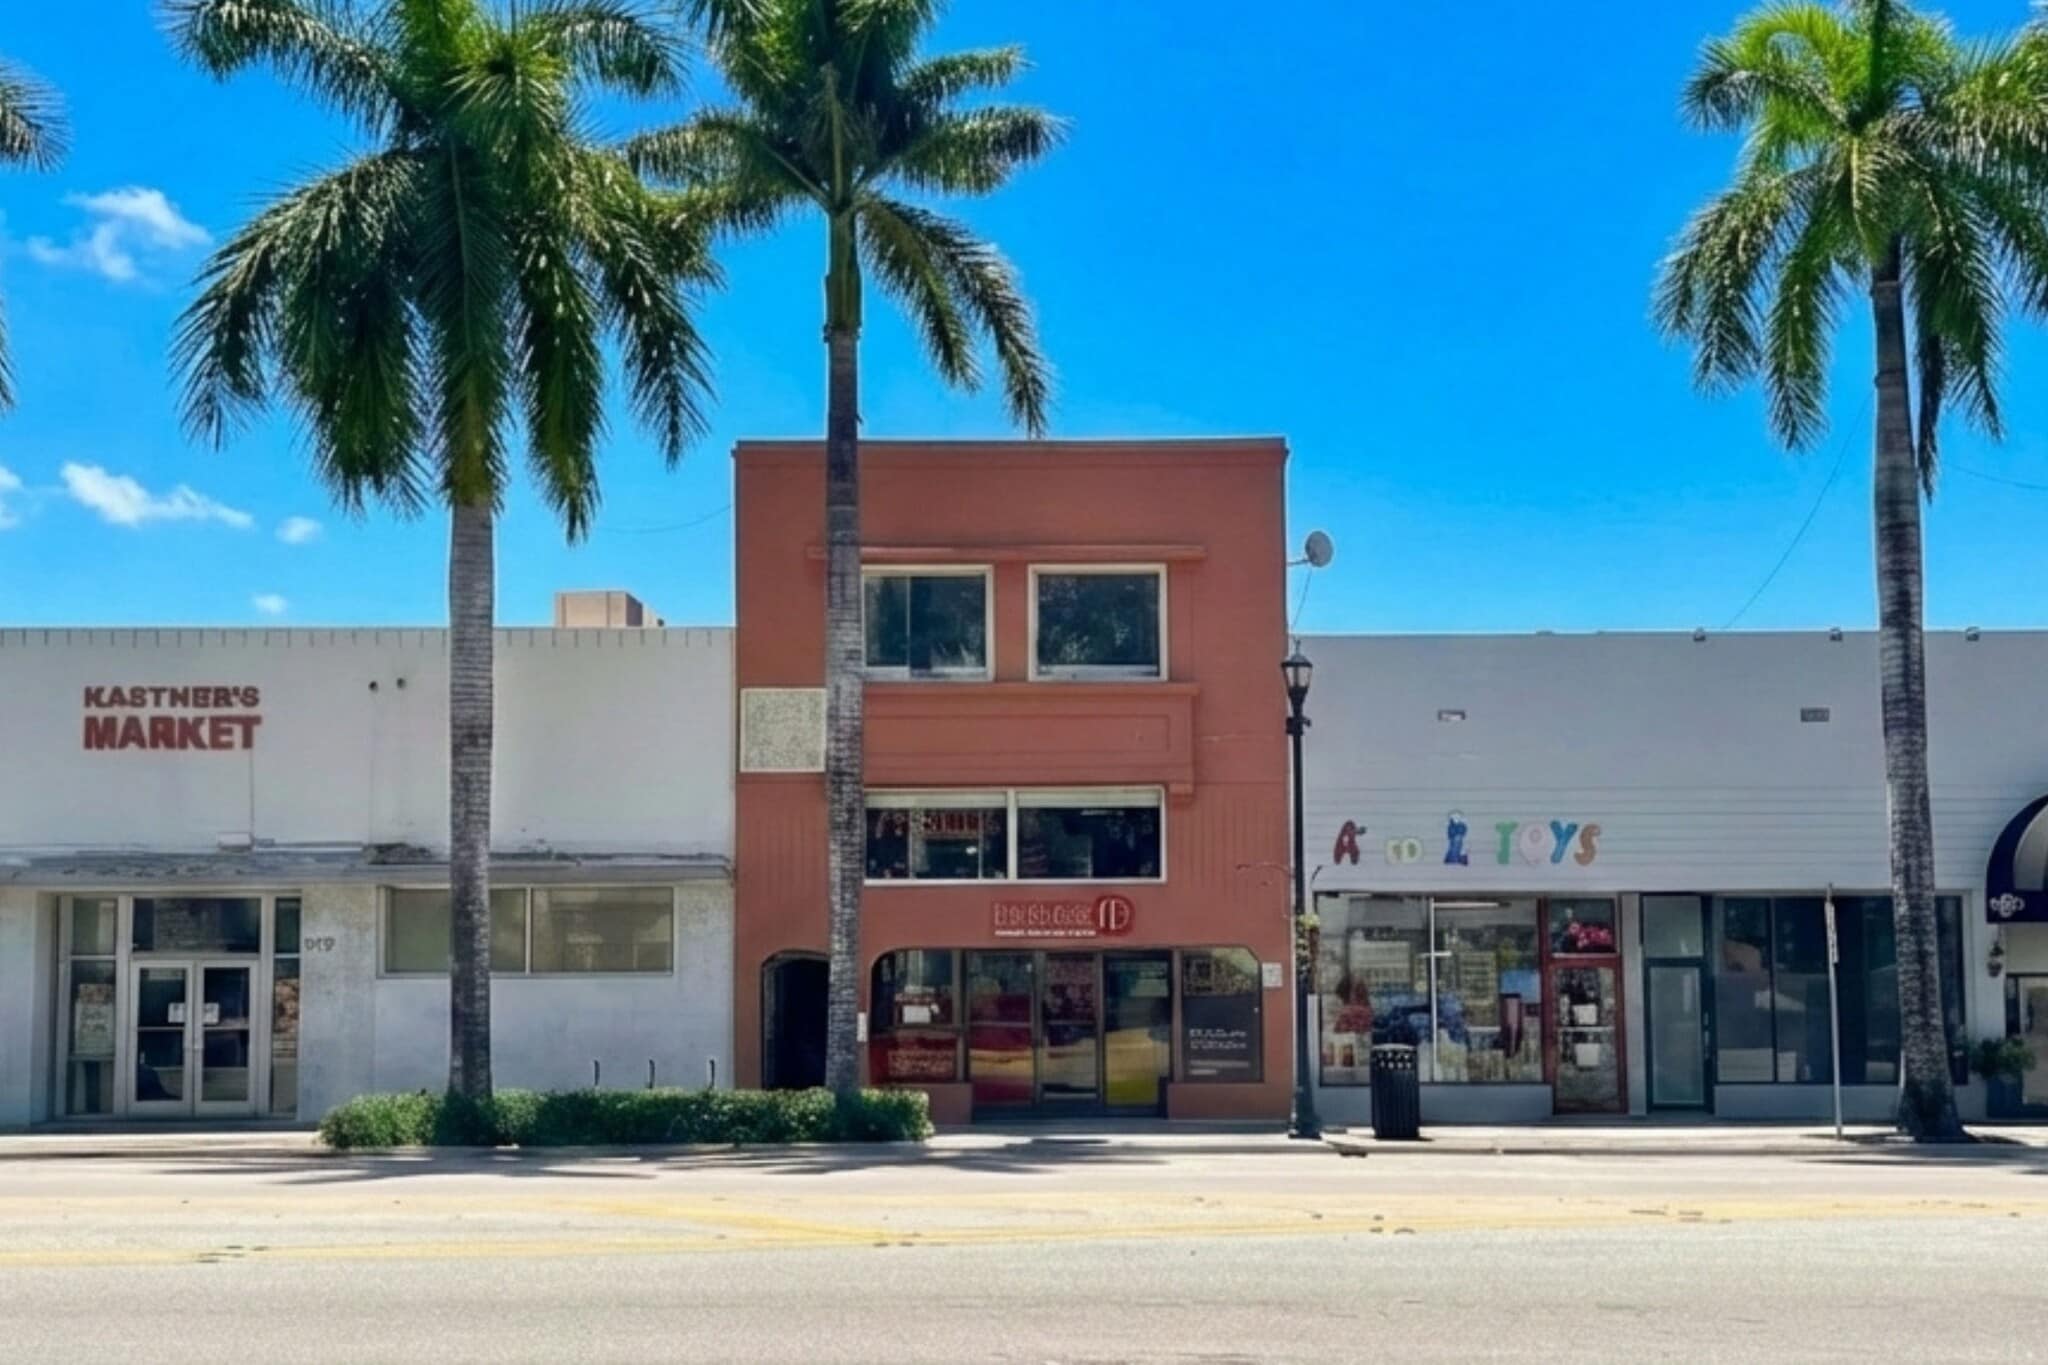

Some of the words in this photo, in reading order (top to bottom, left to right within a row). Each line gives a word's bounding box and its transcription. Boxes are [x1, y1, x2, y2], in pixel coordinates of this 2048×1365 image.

[84, 686, 260, 708] KASTNER'S
[84, 715, 262, 750] MARKET
[1333, 820, 1366, 865] A
[1495, 820, 1600, 867] TOYS
